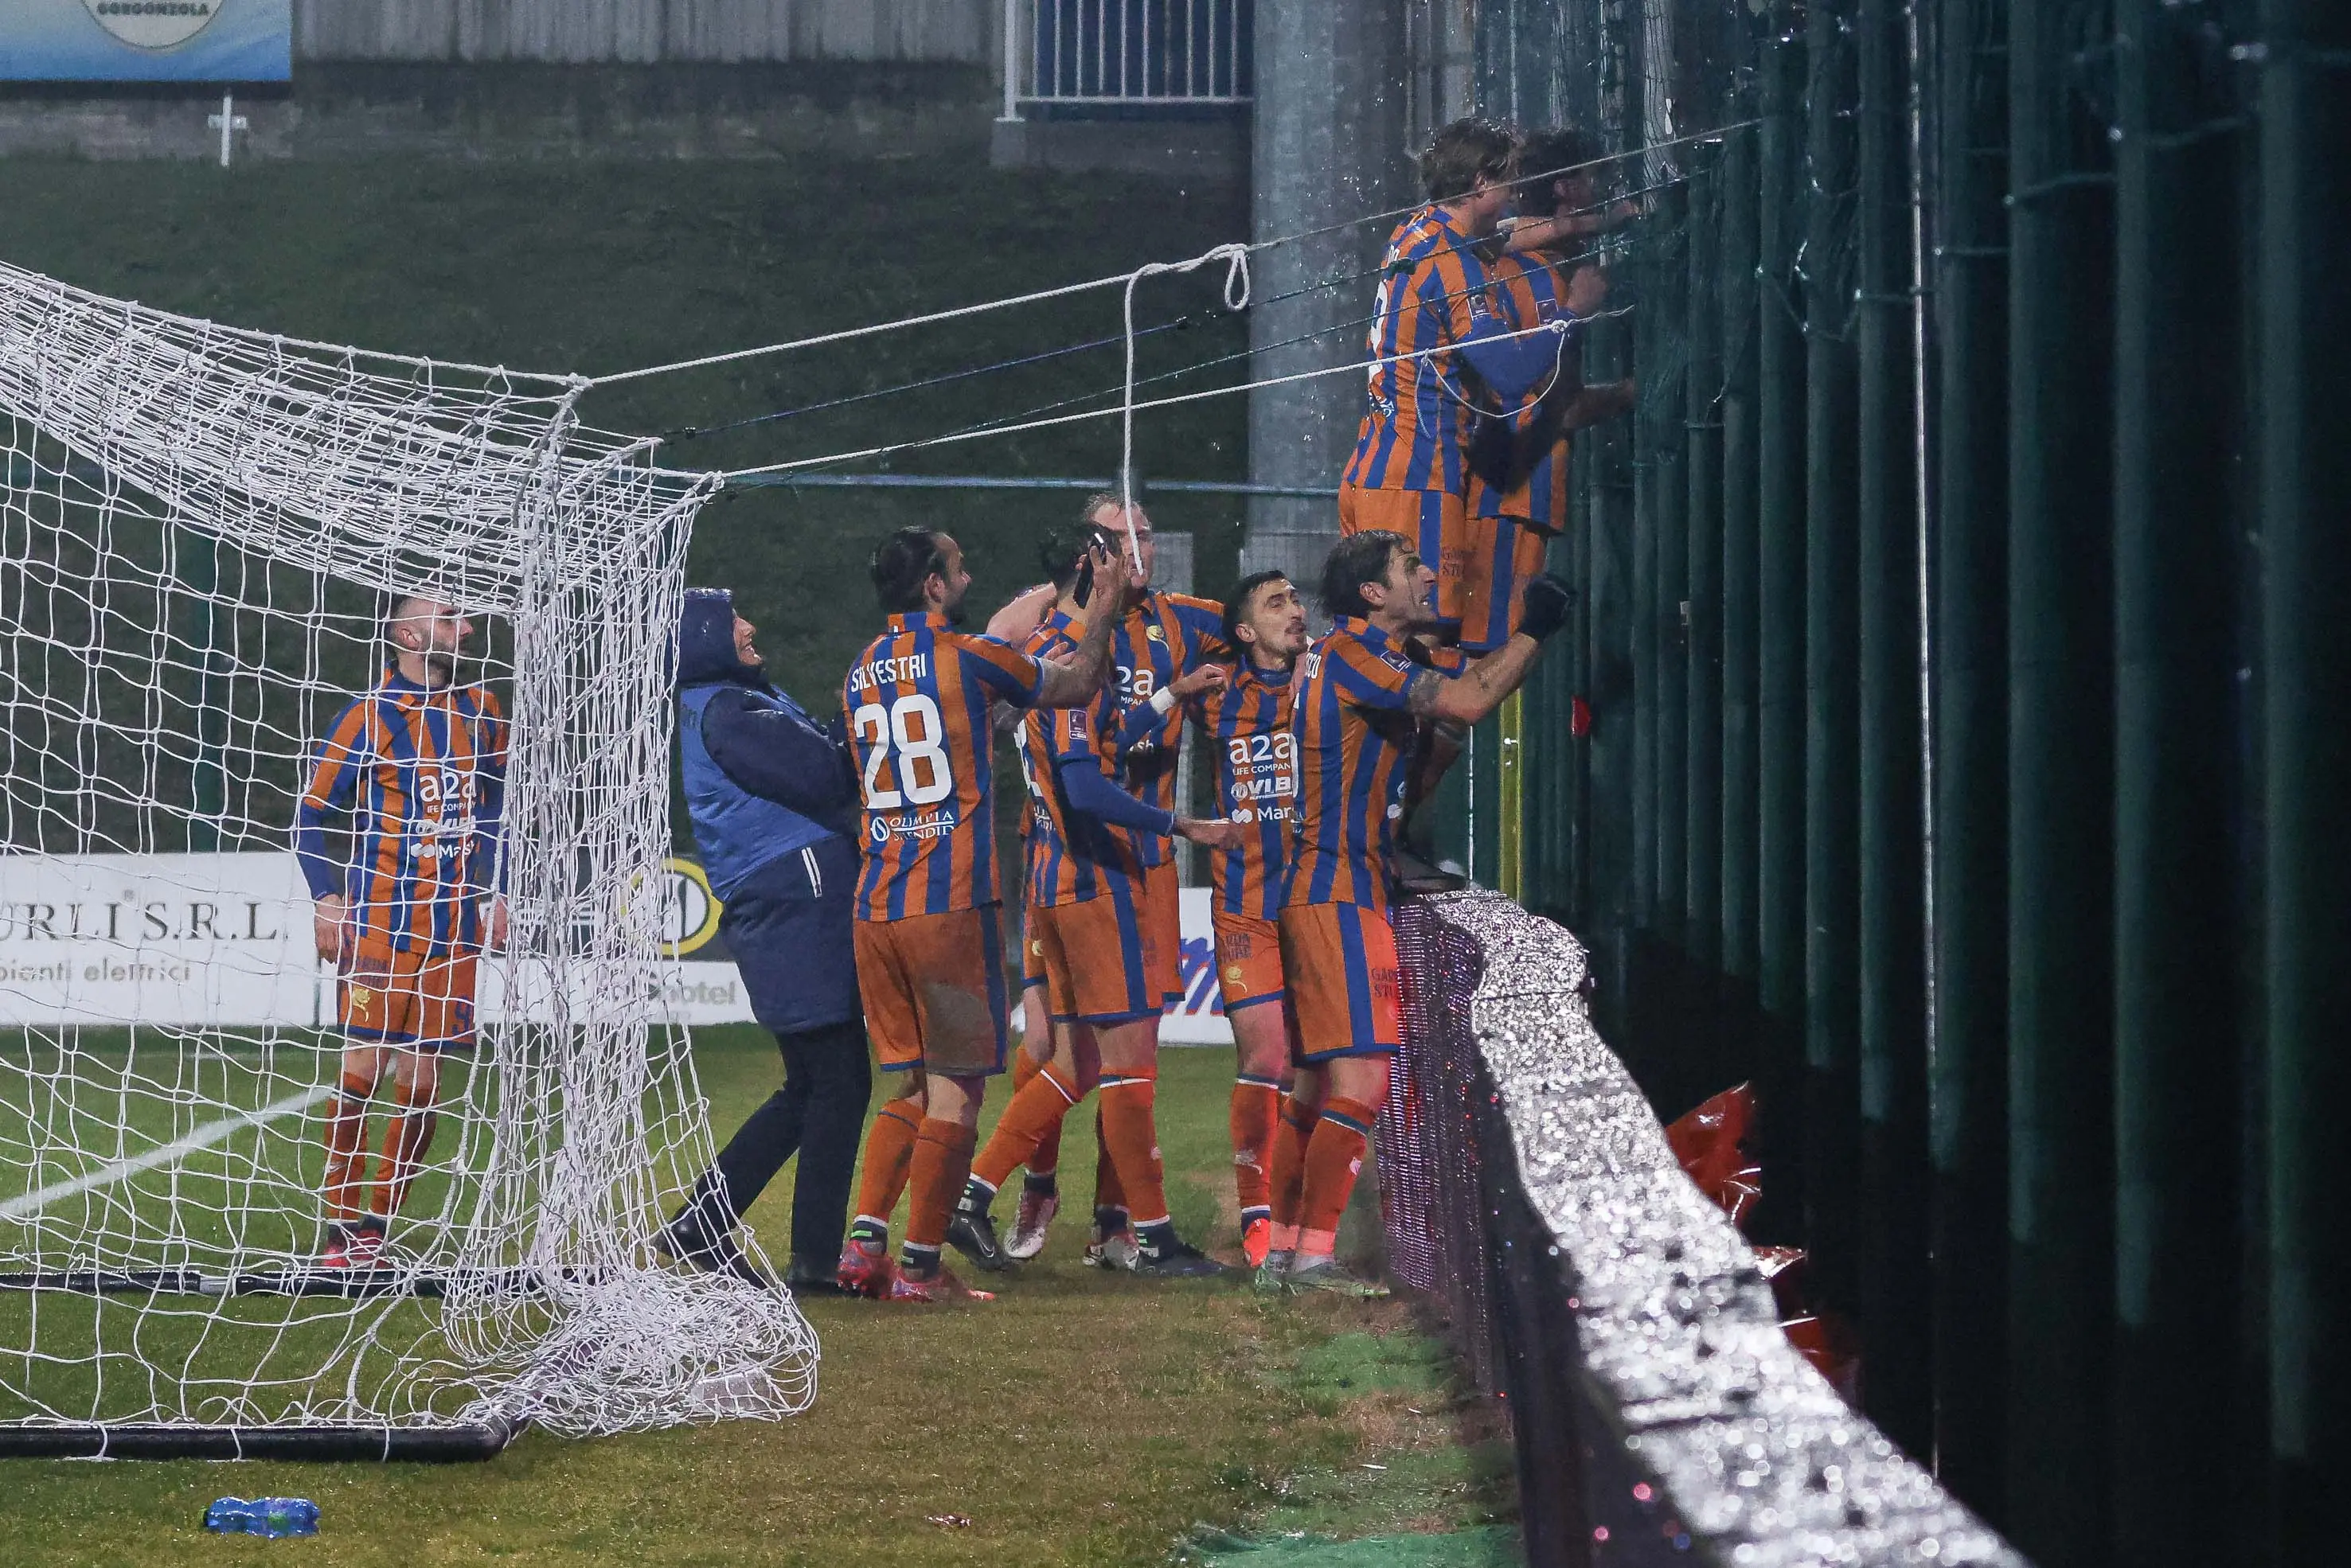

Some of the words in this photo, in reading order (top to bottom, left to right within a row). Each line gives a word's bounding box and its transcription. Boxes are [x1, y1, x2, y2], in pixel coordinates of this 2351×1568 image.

[851, 653, 927, 693] SILVESTRI
[1115, 666, 1154, 697] 2a
[853, 693, 952, 809] 28
[1228, 732, 1291, 765] a2a
[1232, 766, 1249, 776] LIFE
[1251, 763, 1291, 774] COMPAN
[427, 804, 439, 813] IFE
[889, 810, 954, 828] OLIMPIA
